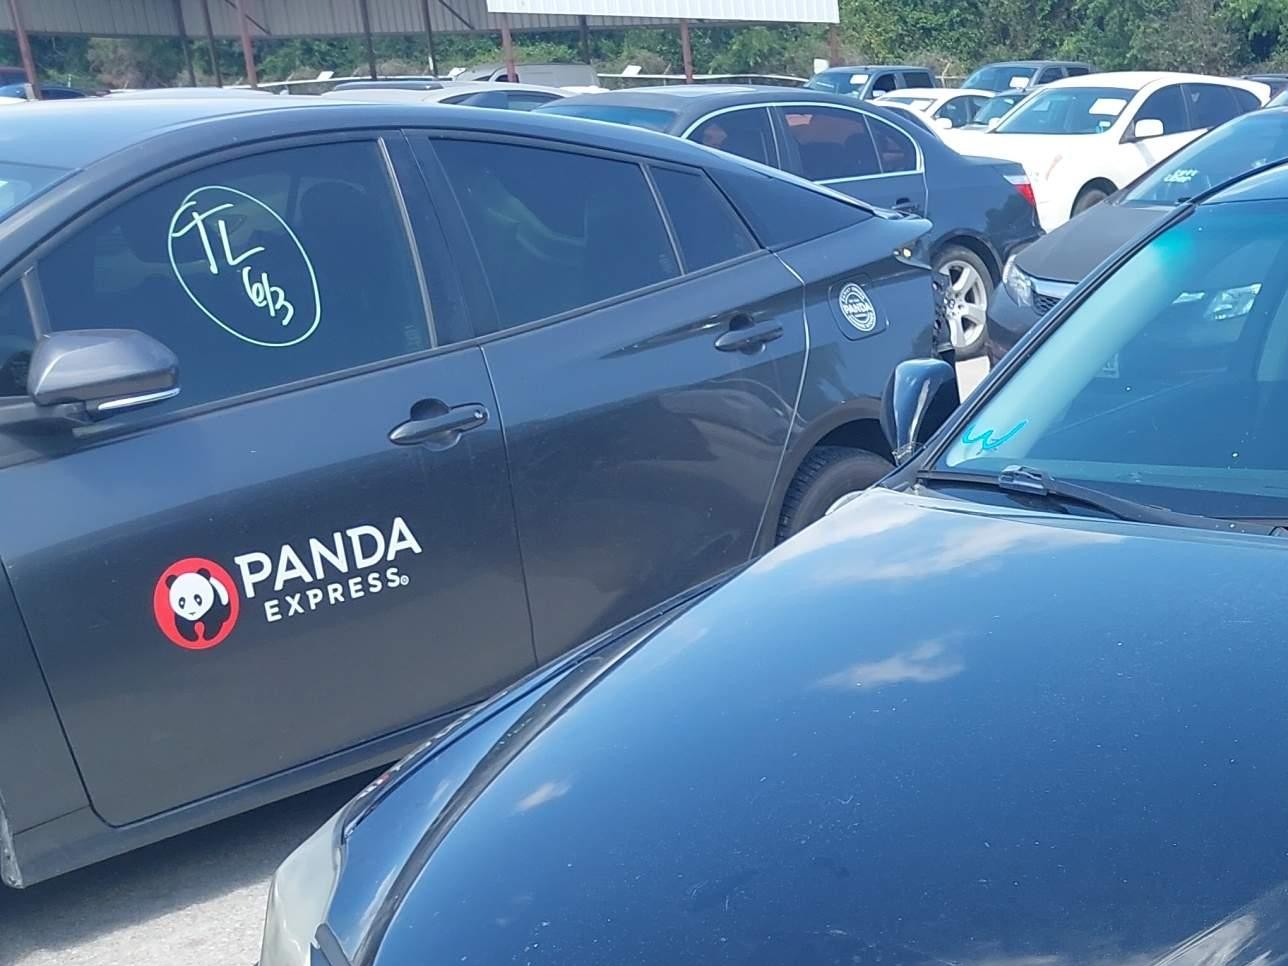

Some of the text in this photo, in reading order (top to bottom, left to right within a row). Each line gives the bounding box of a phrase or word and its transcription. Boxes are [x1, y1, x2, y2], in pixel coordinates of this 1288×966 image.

[171, 202, 266, 275] TL
[234, 516, 423, 599] PANDA
[263, 567, 402, 623] EXPRESS
